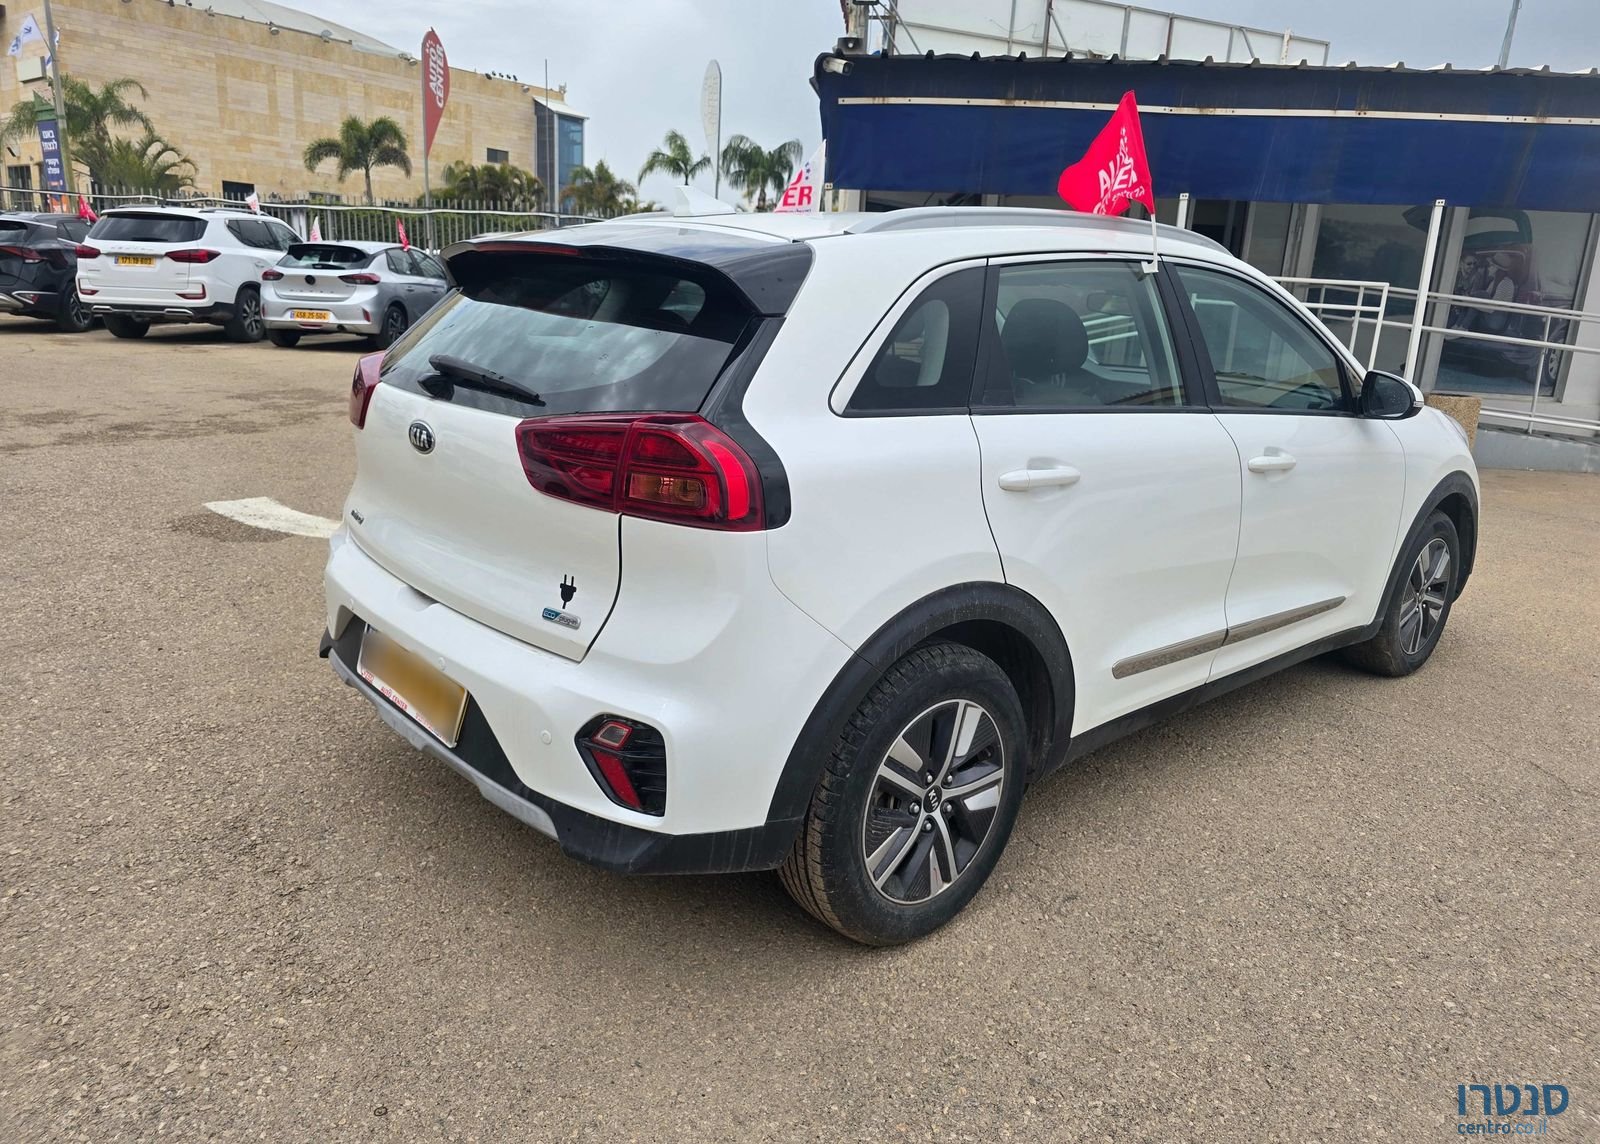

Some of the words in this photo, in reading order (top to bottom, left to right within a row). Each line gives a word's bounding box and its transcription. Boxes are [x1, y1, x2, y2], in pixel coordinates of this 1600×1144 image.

[429, 47, 438, 95] AUTO
[436, 43, 445, 109] CENTER
[410, 426, 430, 449] KIA
[928, 788, 939, 811] KIA
